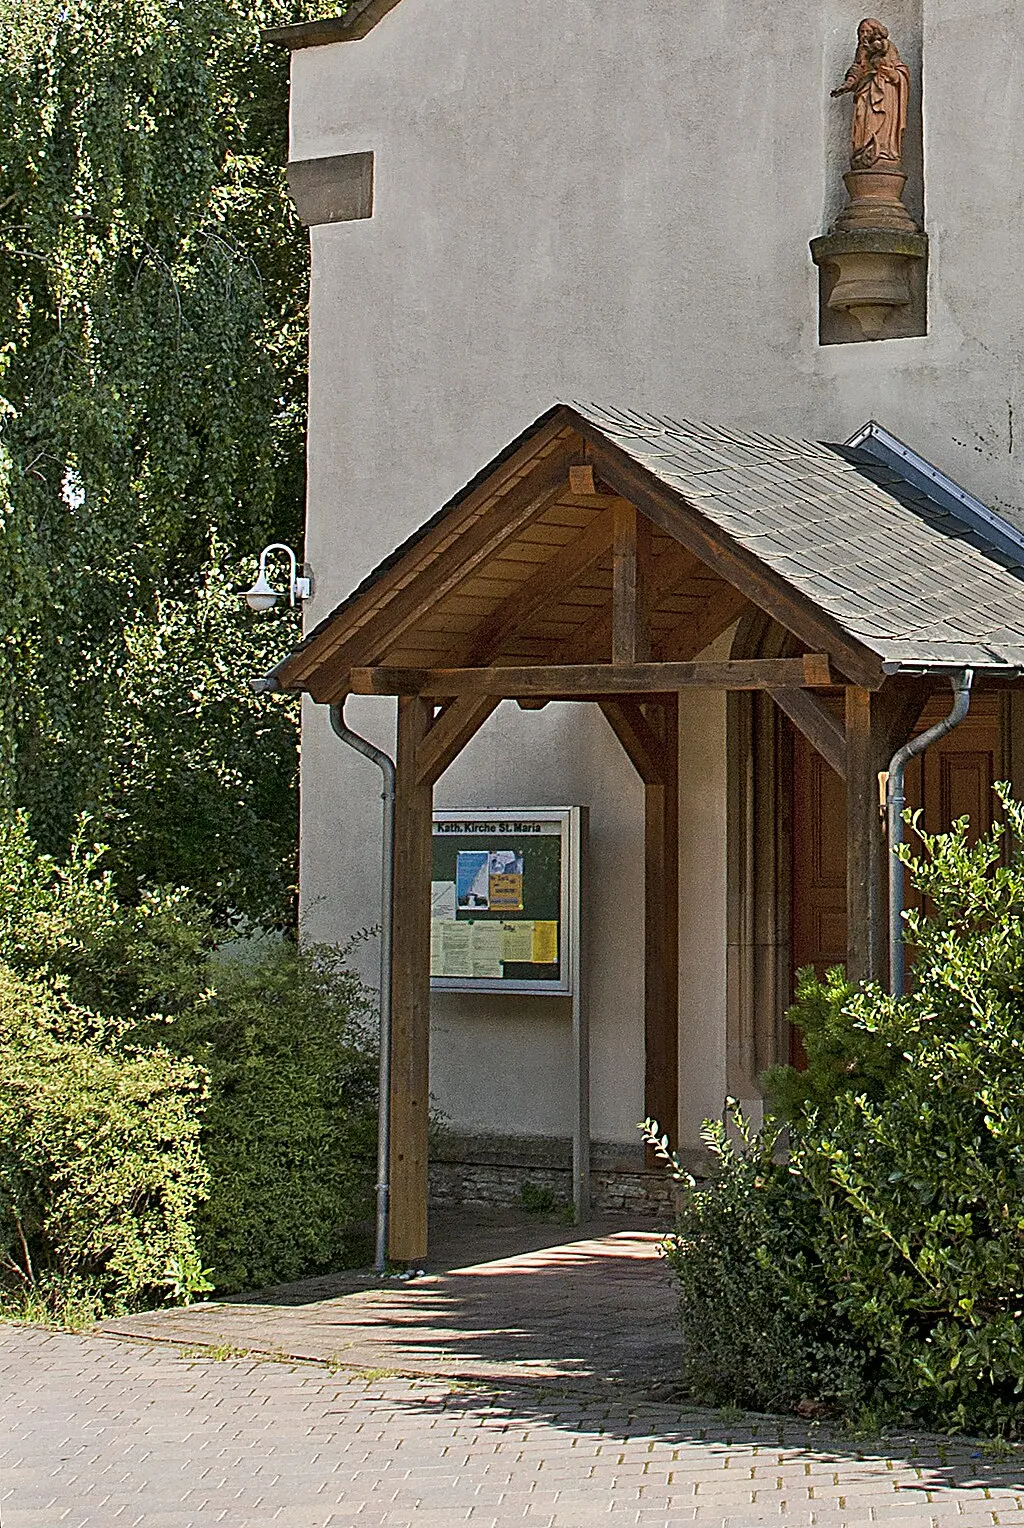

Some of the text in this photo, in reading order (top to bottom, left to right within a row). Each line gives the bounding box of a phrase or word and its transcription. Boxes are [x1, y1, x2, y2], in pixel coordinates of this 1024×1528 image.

[437, 822, 541, 832] Kath. Kirche St. Maria
